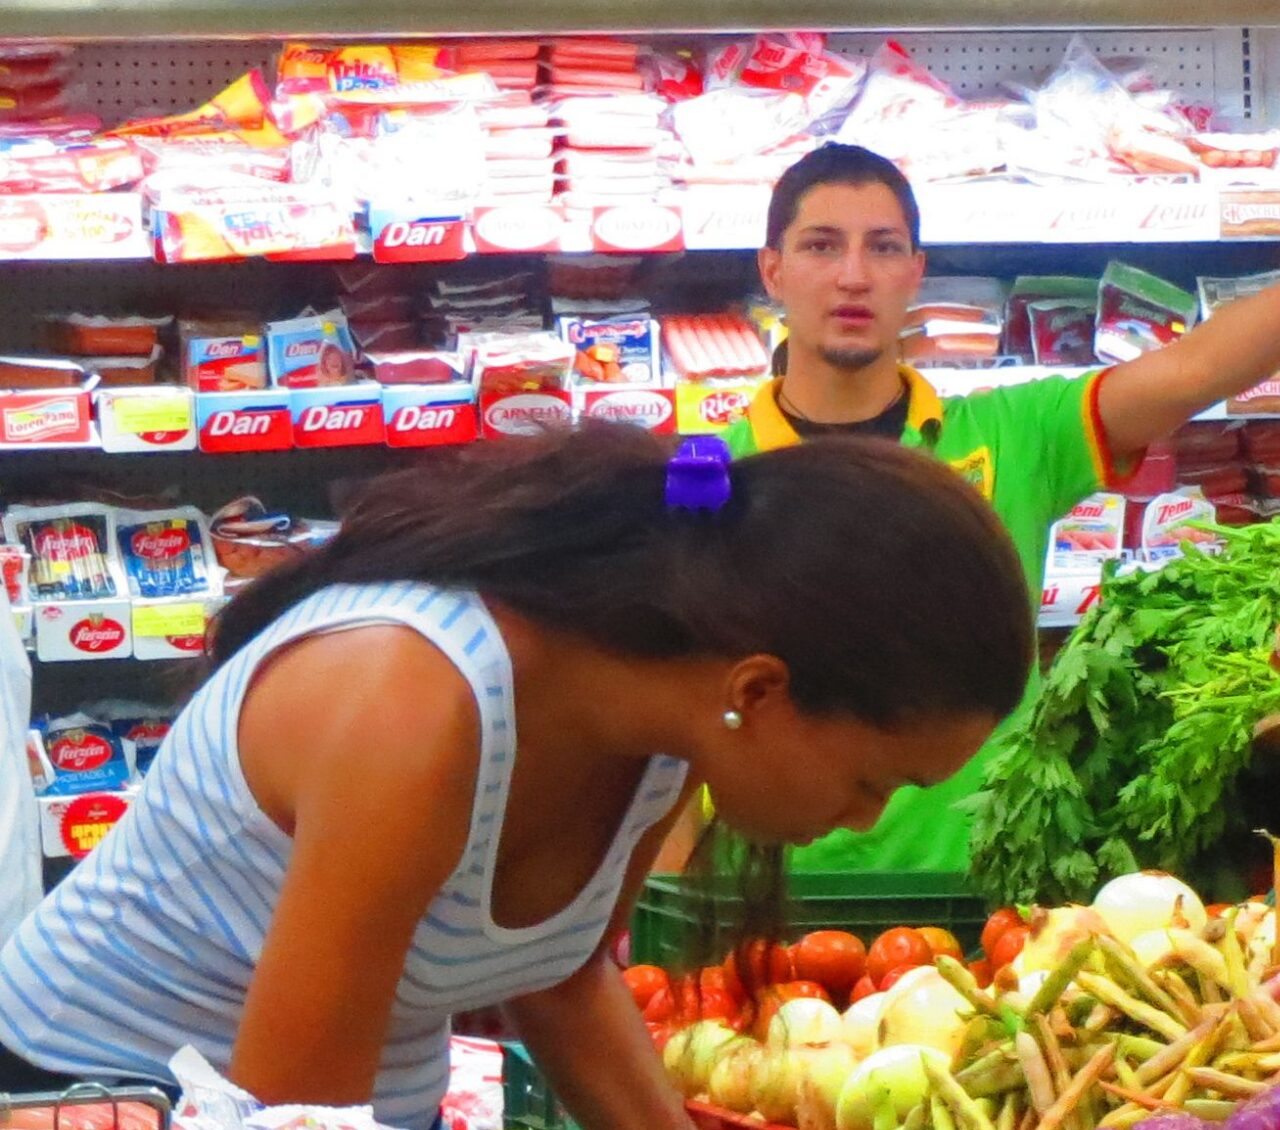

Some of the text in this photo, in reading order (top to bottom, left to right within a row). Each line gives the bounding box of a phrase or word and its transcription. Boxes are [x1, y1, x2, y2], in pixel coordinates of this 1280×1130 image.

[385, 223, 446, 248] Dan
[210, 411, 272, 436] Dan
[303, 406, 364, 431] Dan
[396, 406, 456, 431] Dan
